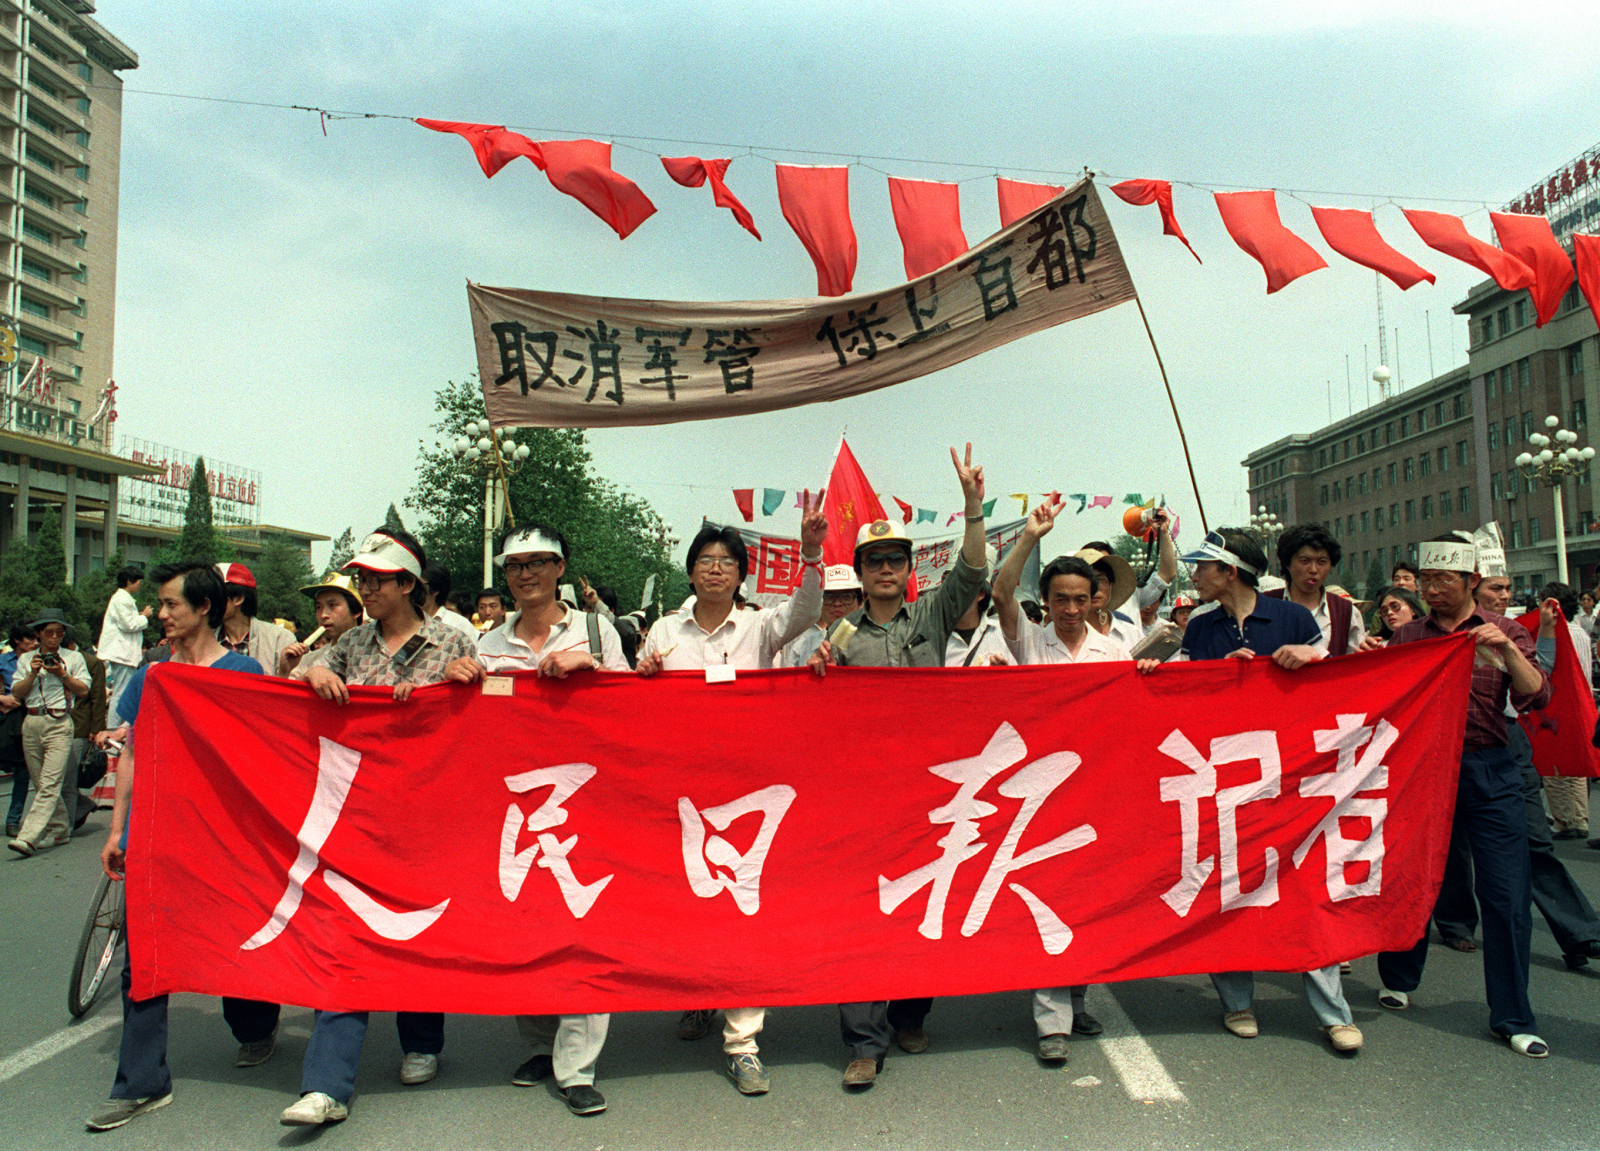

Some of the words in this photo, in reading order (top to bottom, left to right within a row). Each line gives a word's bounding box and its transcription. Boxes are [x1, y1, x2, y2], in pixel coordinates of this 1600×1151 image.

[490, 319, 762, 406] 取消军管
[215, 500, 236, 513] YOU
[829, 568, 848, 578] CMC
